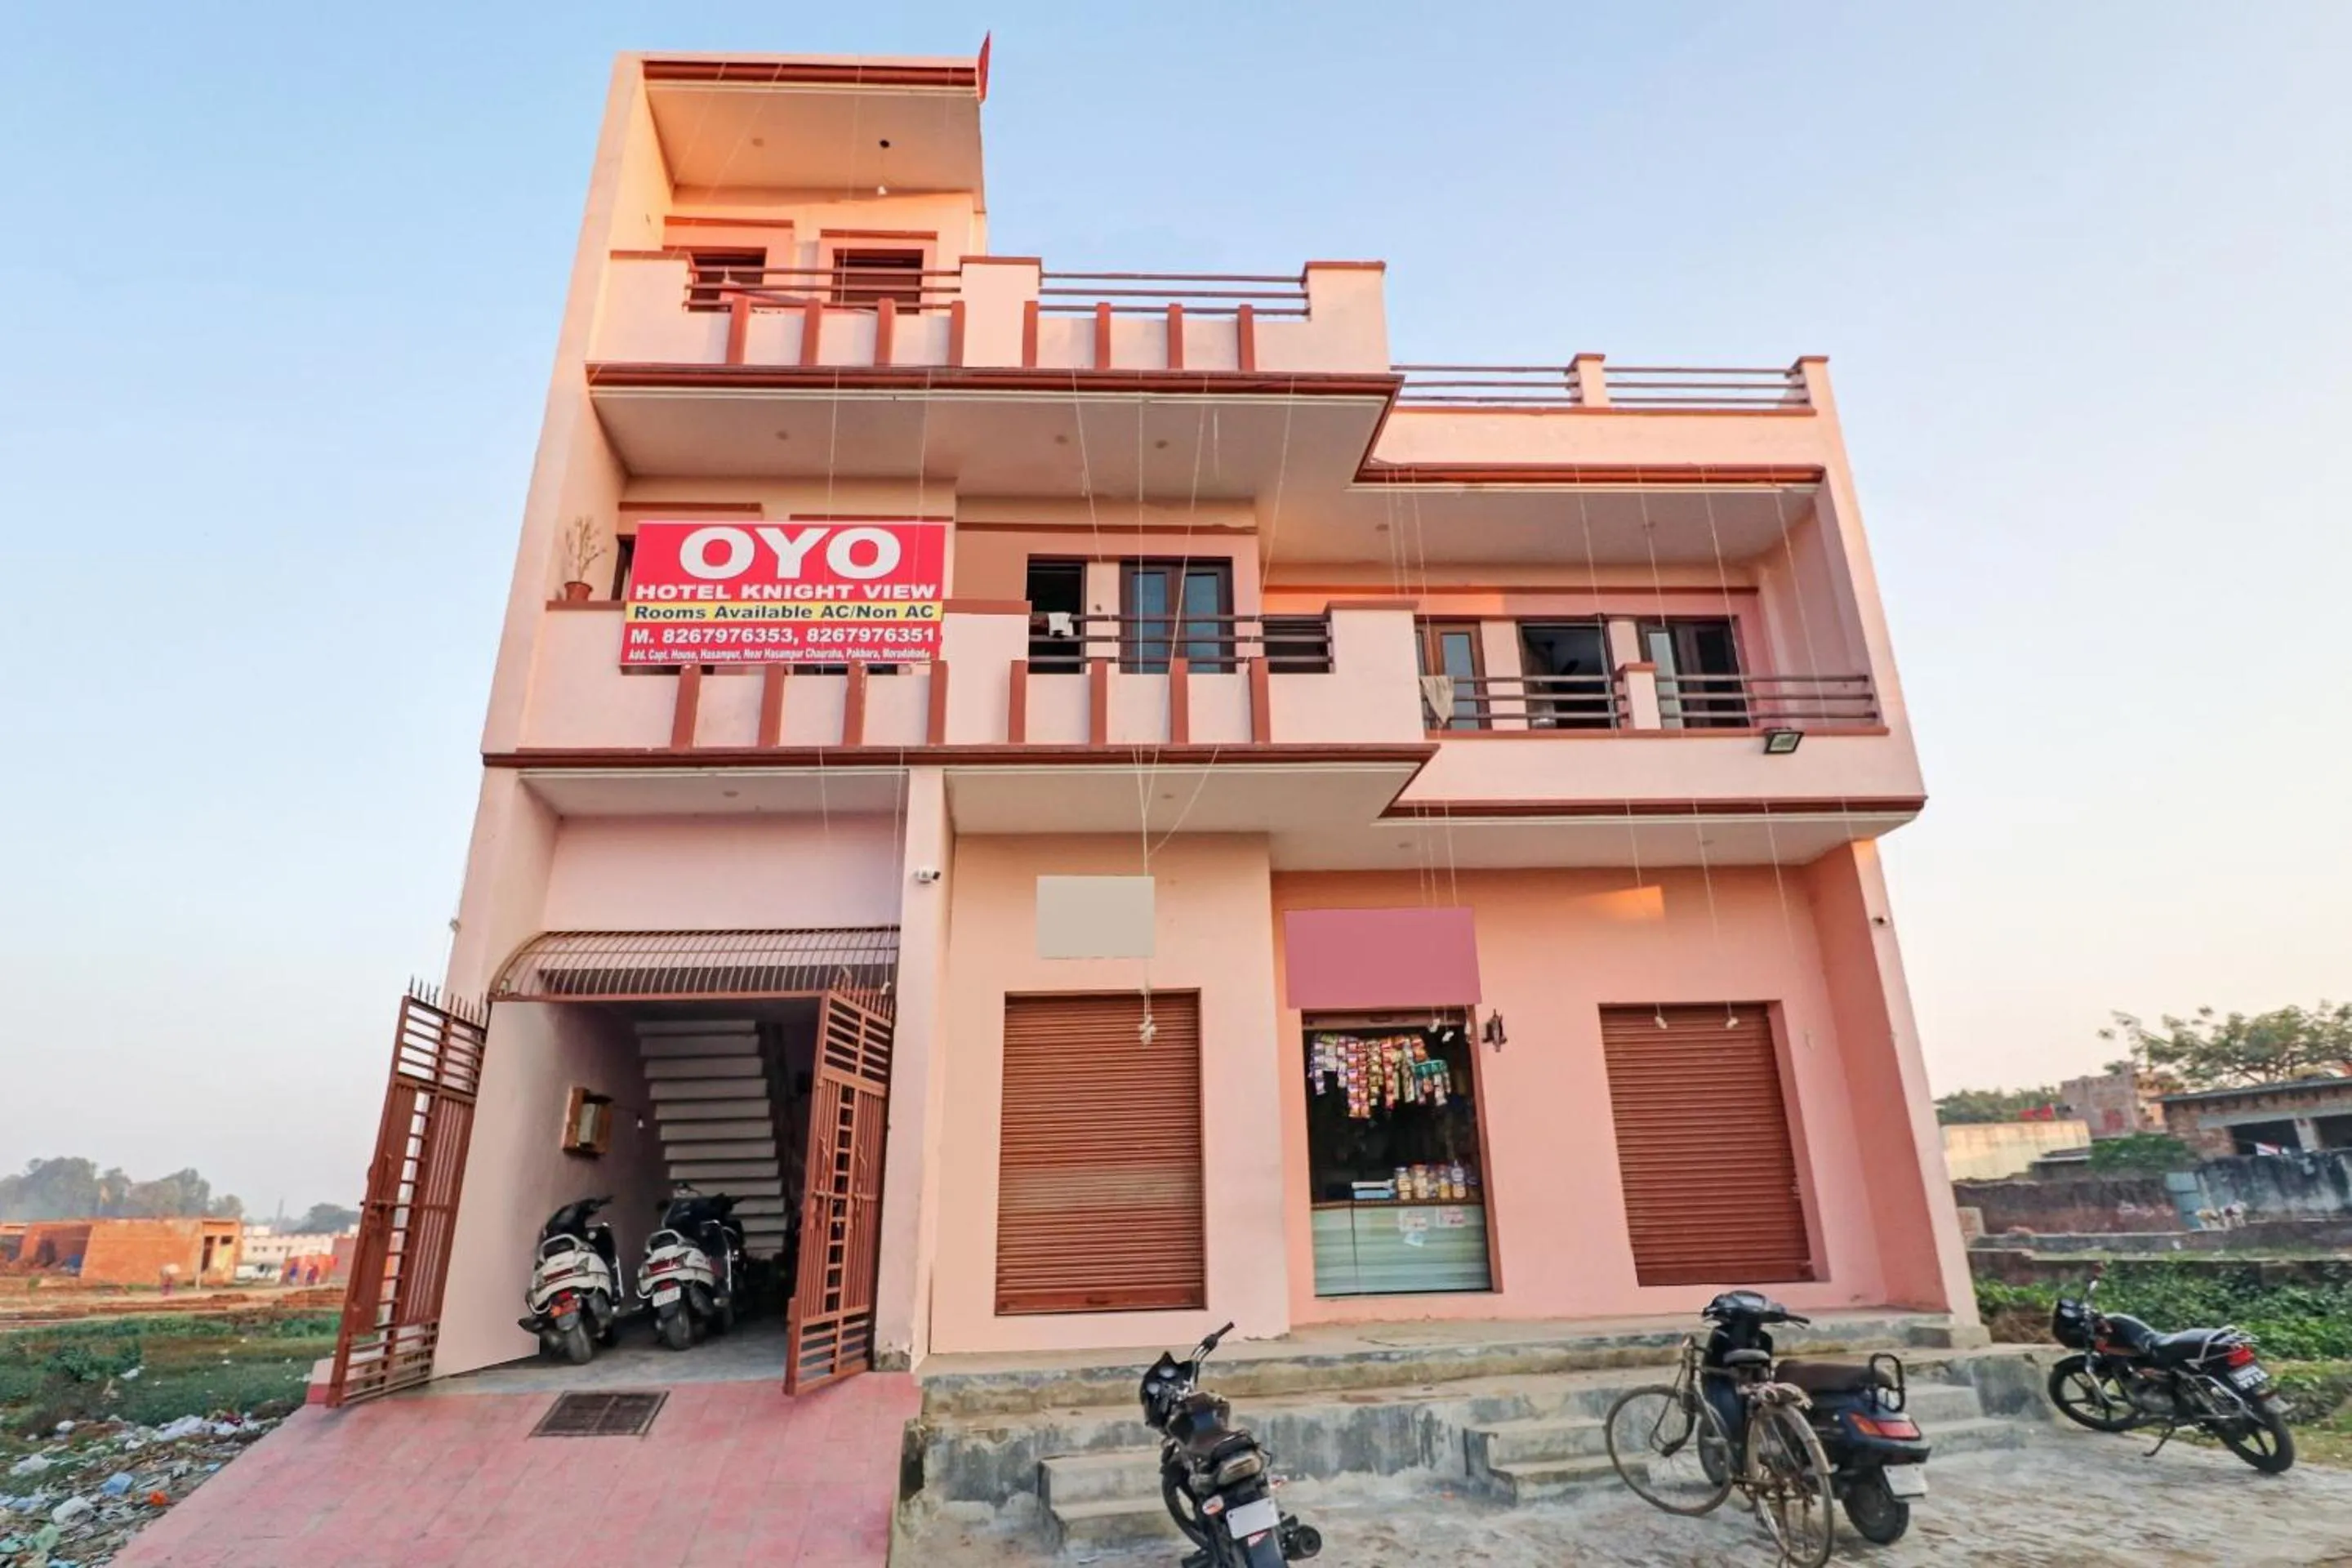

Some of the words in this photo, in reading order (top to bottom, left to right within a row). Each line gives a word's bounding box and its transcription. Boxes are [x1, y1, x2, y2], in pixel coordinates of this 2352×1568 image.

[679, 526, 902, 580] OYO
[635, 584, 732, 599] HOTEL
[741, 584, 854, 599] KNIGHT
[862, 584, 937, 599] VIEW
[634, 606, 706, 619] Rooms
[714, 605, 813, 619] Available
[820, 604, 897, 618] AC/Non
[904, 604, 933, 618] AC
[630, 628, 654, 644] M.
[662, 628, 799, 645] 8267976353,
[806, 627, 933, 642] 8267976351
